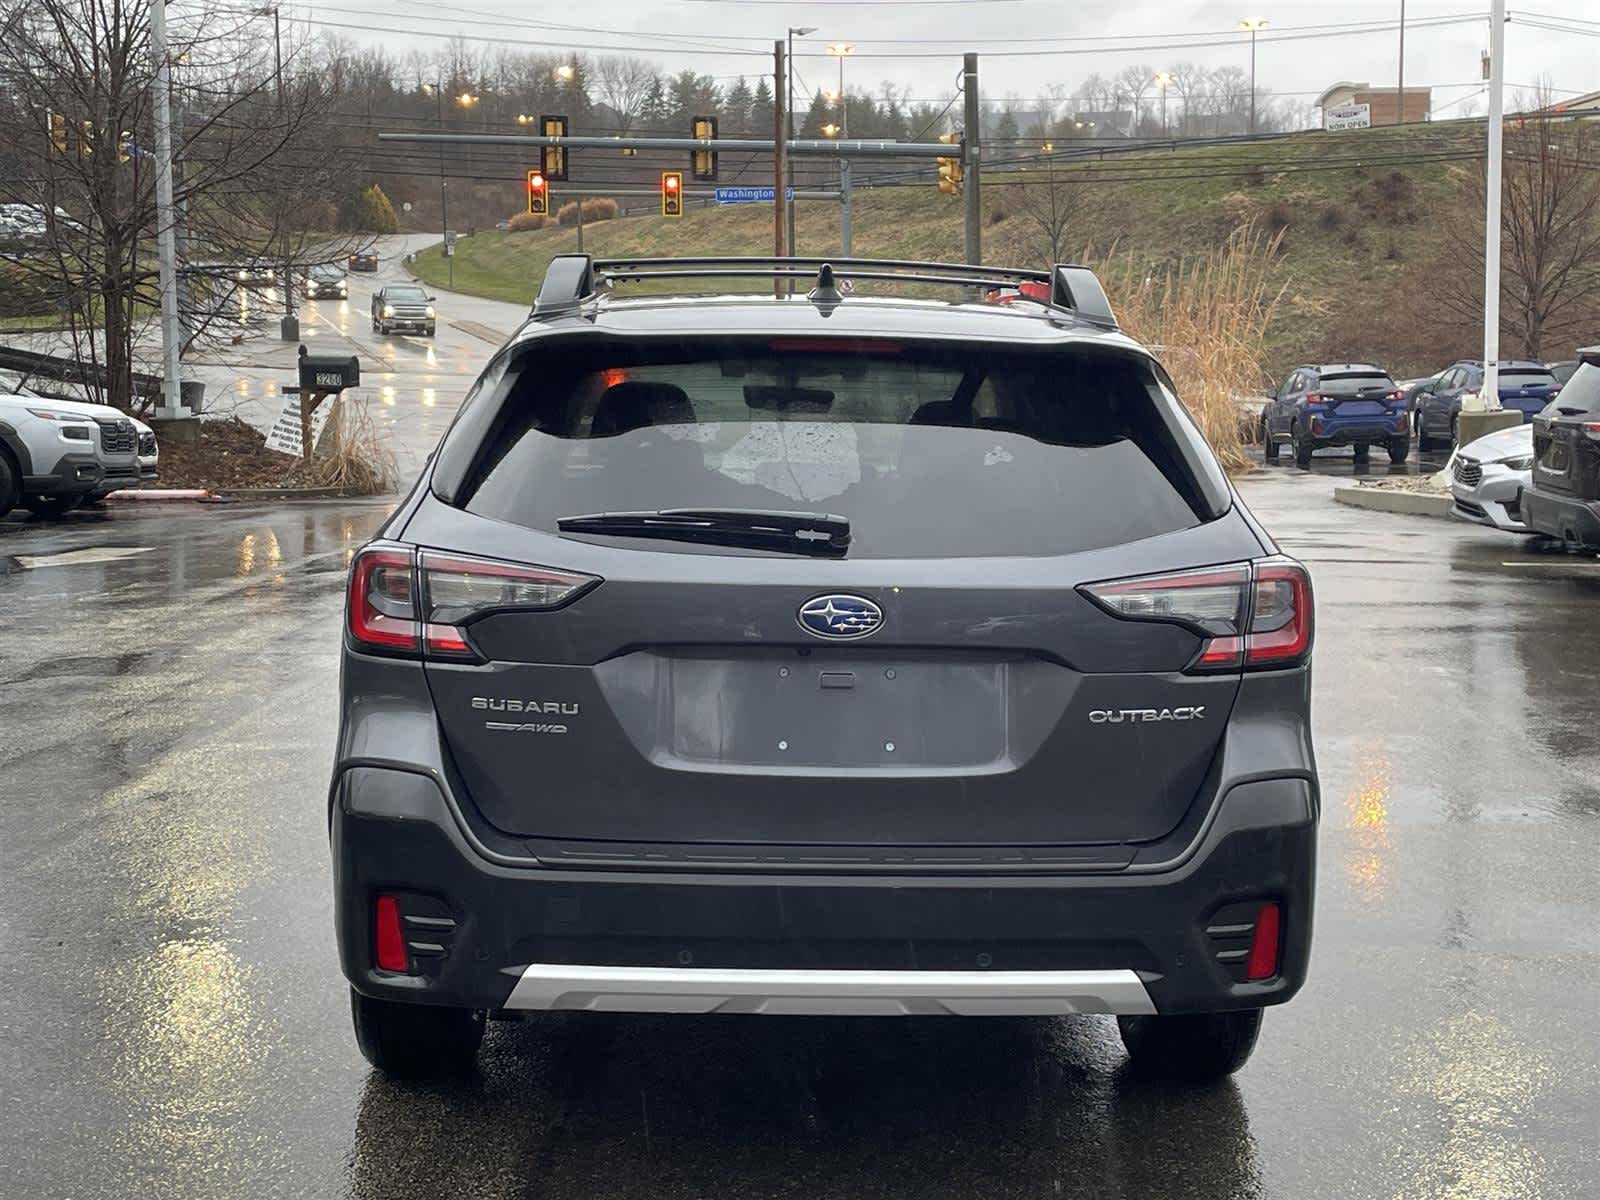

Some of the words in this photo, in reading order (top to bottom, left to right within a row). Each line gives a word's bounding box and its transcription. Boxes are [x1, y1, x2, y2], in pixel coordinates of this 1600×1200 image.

[1347, 119, 1368, 128] OPEN
[719, 189, 775, 200] Washington
[471, 697, 579, 714] SUBARU
[1088, 706, 1205, 723] OUTBACK
[516, 723, 568, 733] AWD
